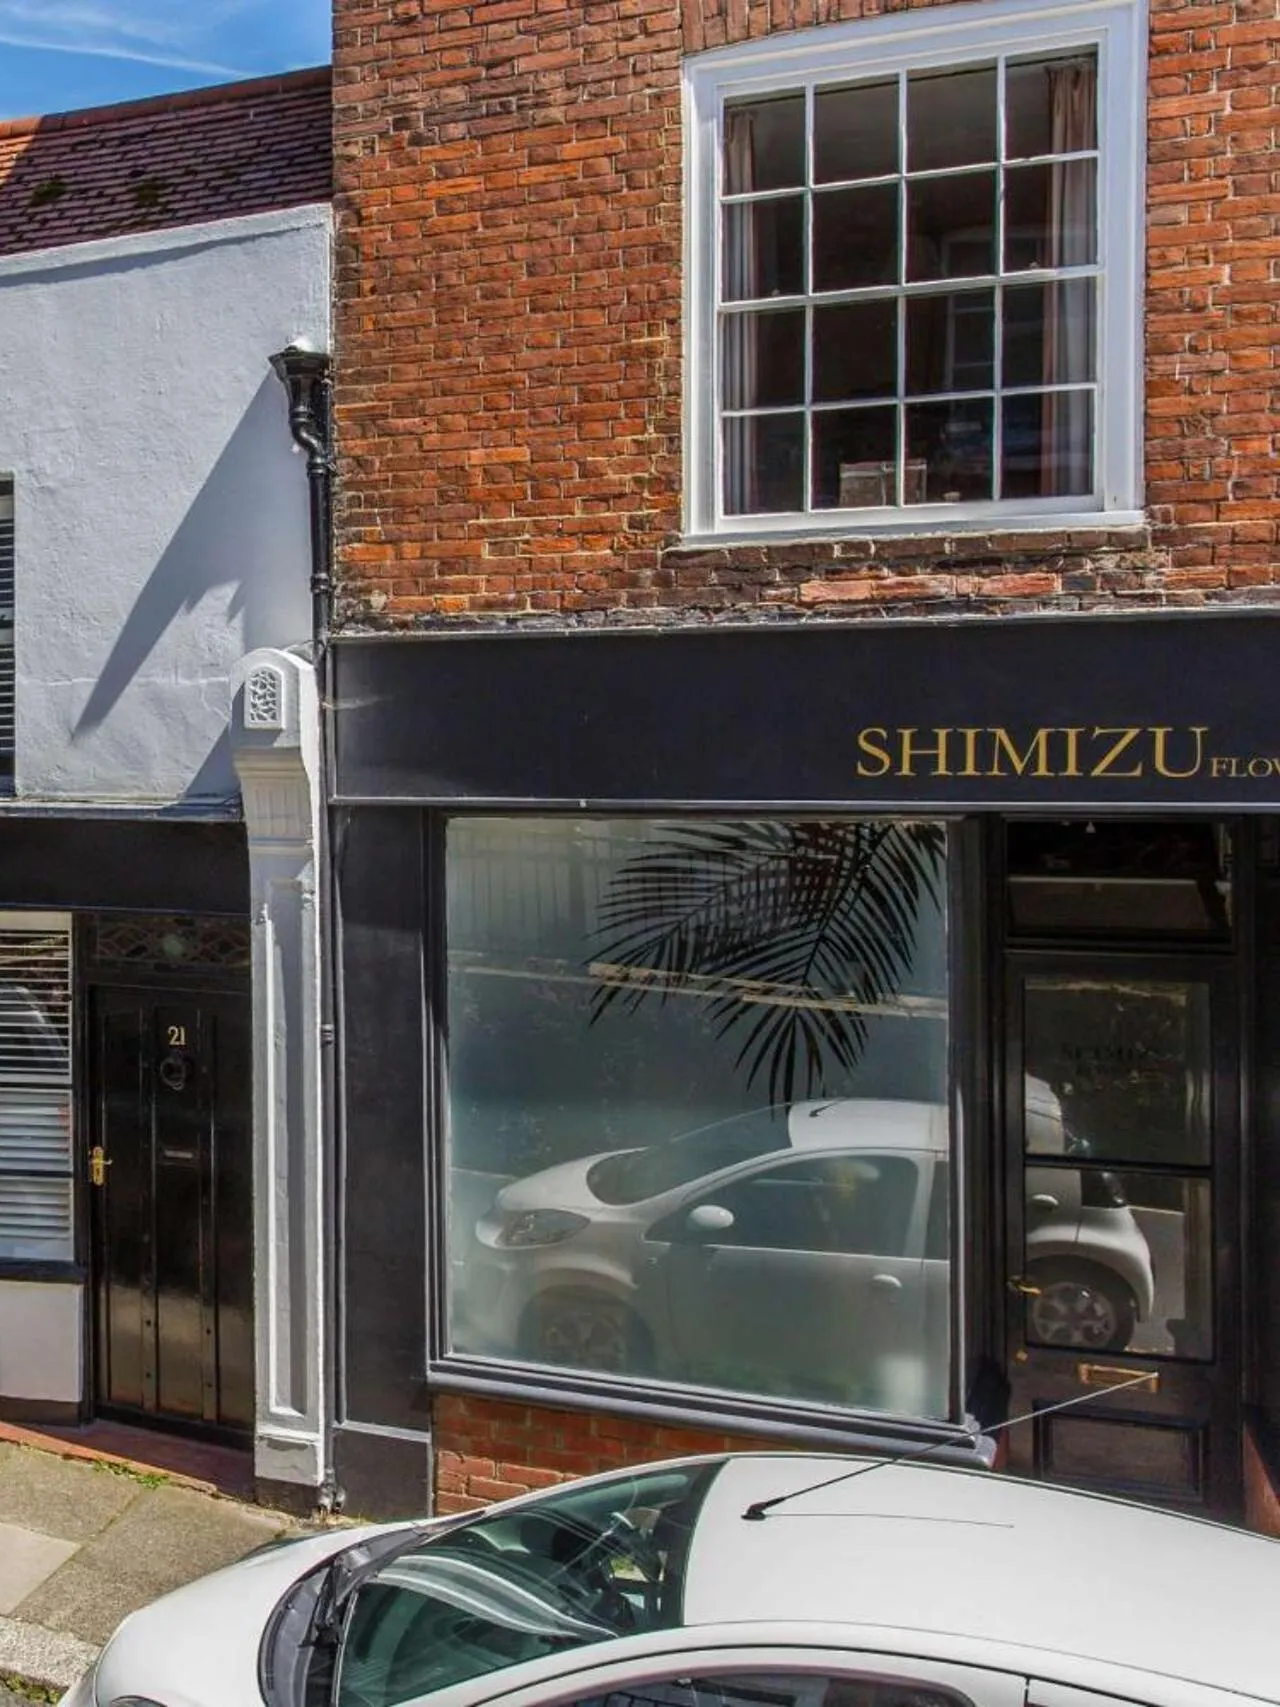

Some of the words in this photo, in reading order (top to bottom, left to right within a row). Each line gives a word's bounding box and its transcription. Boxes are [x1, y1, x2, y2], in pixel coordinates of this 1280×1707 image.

[856, 727, 1209, 778] SHIMIZU
[1210, 757, 1280, 778] FLO
[167, 1026, 186, 1046] 21
